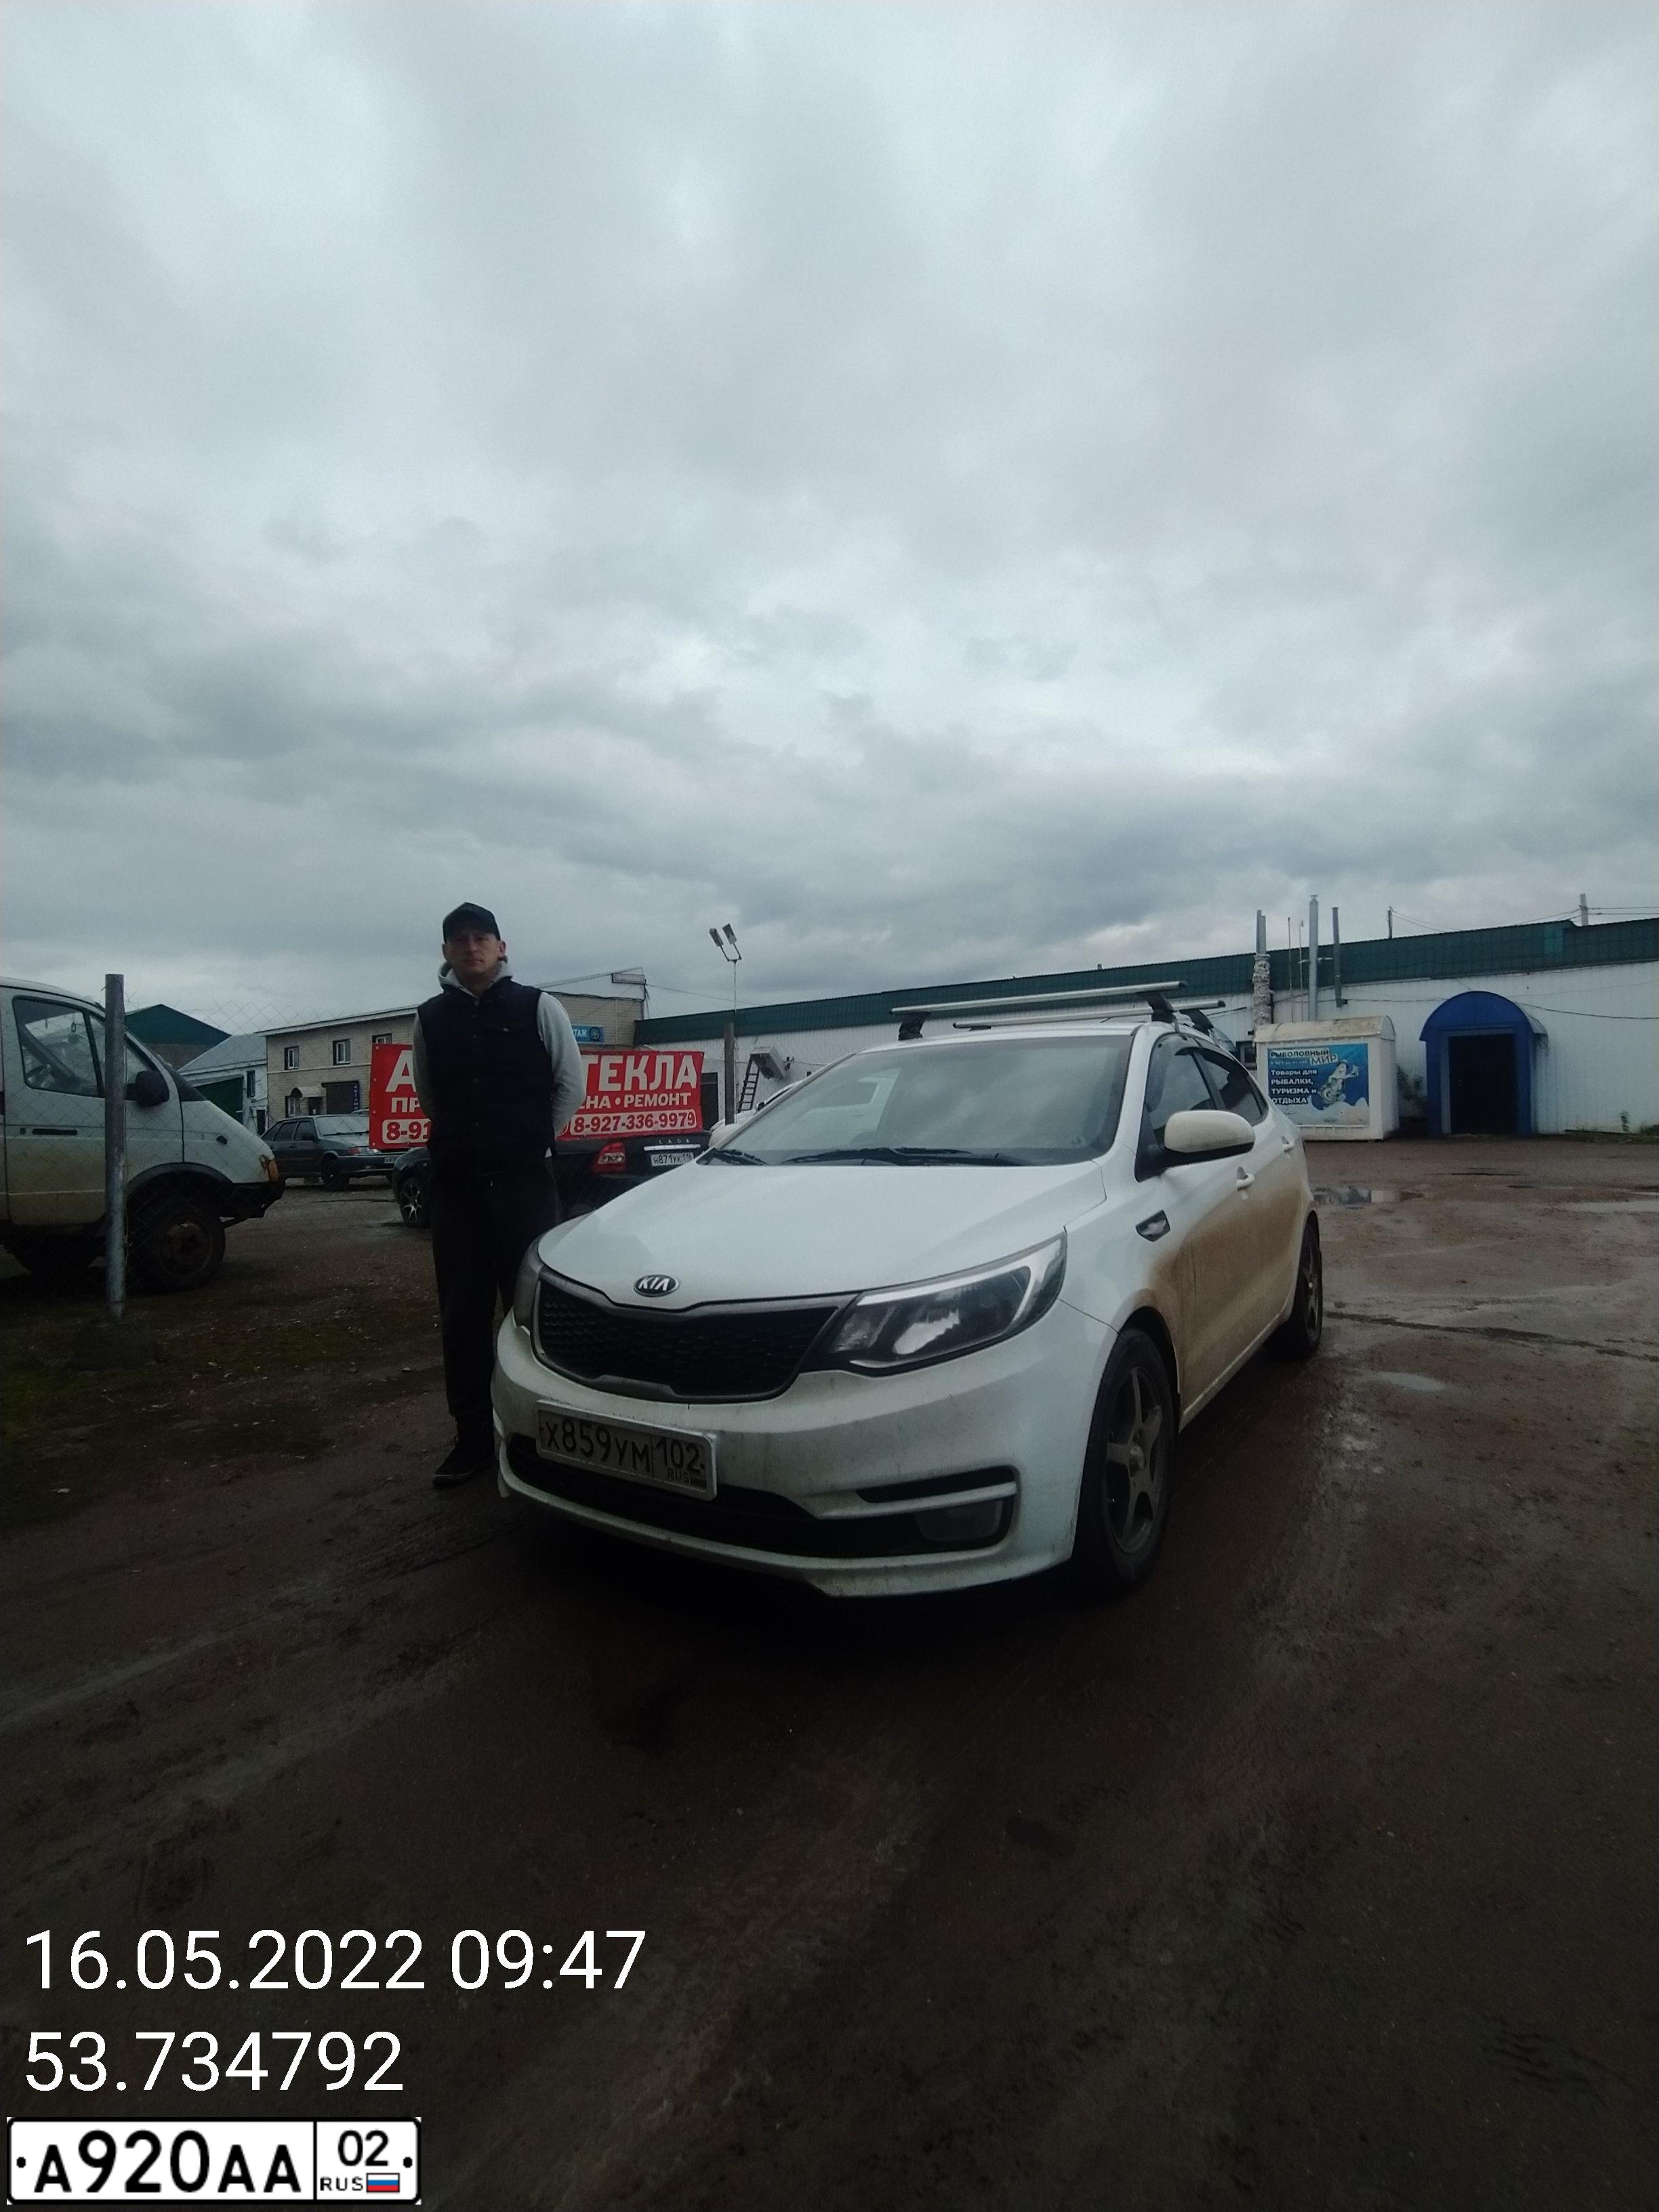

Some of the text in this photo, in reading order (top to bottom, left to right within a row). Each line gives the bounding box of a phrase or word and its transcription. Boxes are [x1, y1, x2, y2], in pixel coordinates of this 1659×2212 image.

[1311, 1054, 1337, 1065] МИР
[579, 1094, 611, 1109] НА
[623, 1092, 692, 1108] РЕМОНТ
[573, 1111, 696, 1133] 8-927-336-9979
[638, 1276, 670, 1292] KIA
[667, 1468, 692, 1484] RUS
